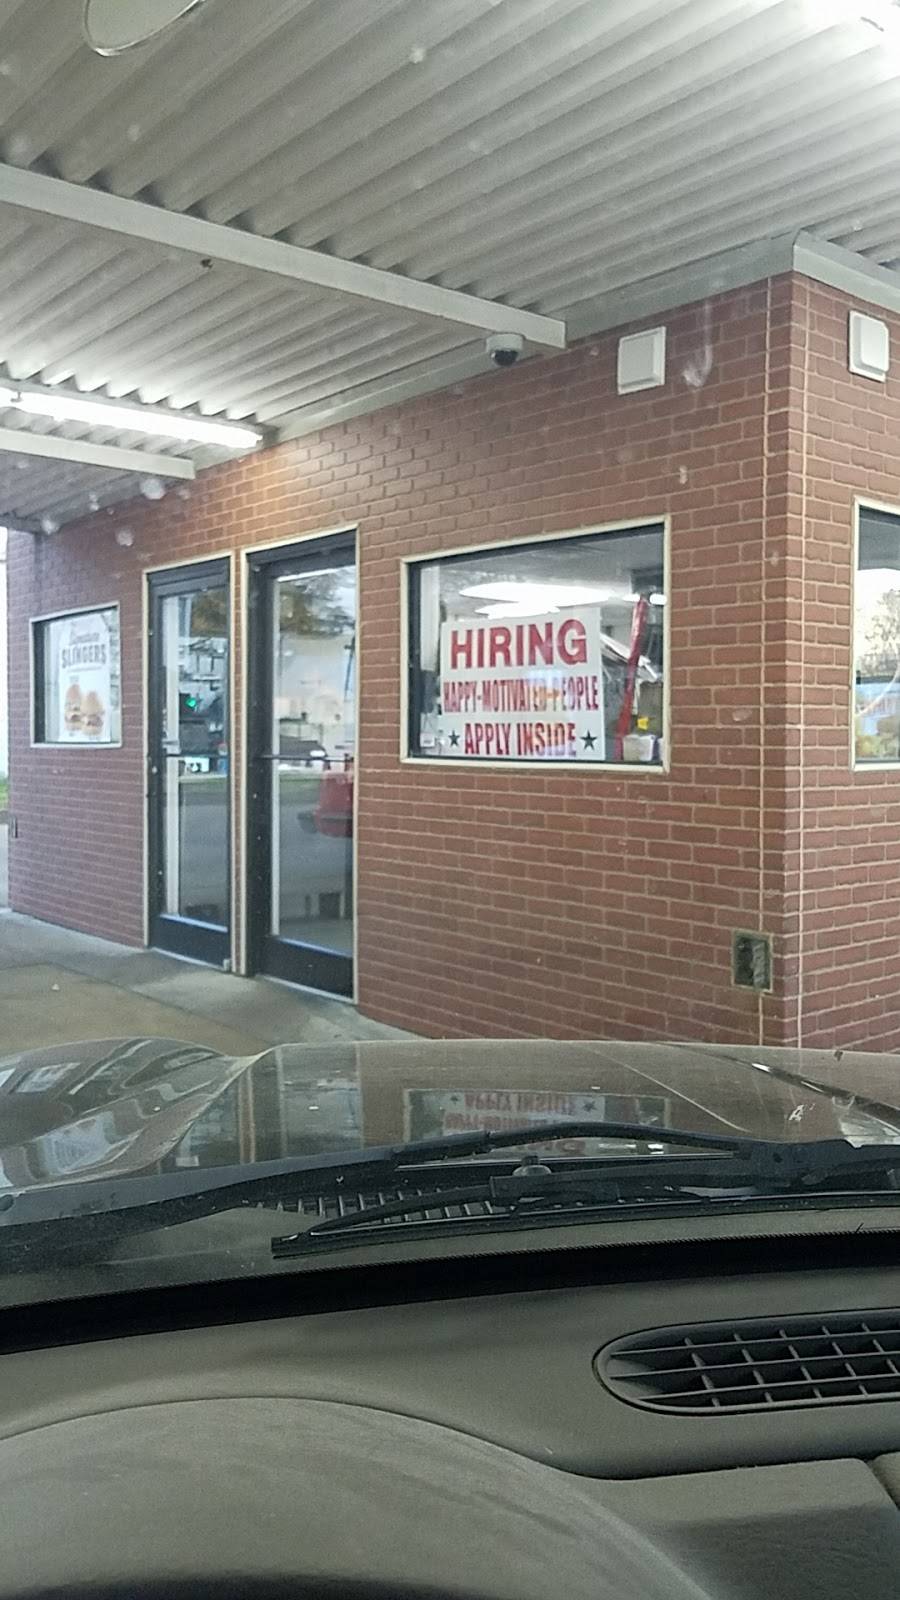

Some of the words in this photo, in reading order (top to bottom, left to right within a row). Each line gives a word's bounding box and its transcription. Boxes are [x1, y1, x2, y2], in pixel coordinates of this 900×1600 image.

[61, 643, 107, 669] SLINGERS
[450, 619, 588, 670] HIRING
[464, 722, 511, 756] APPLY
[516, 722, 577, 758] INSIDE
